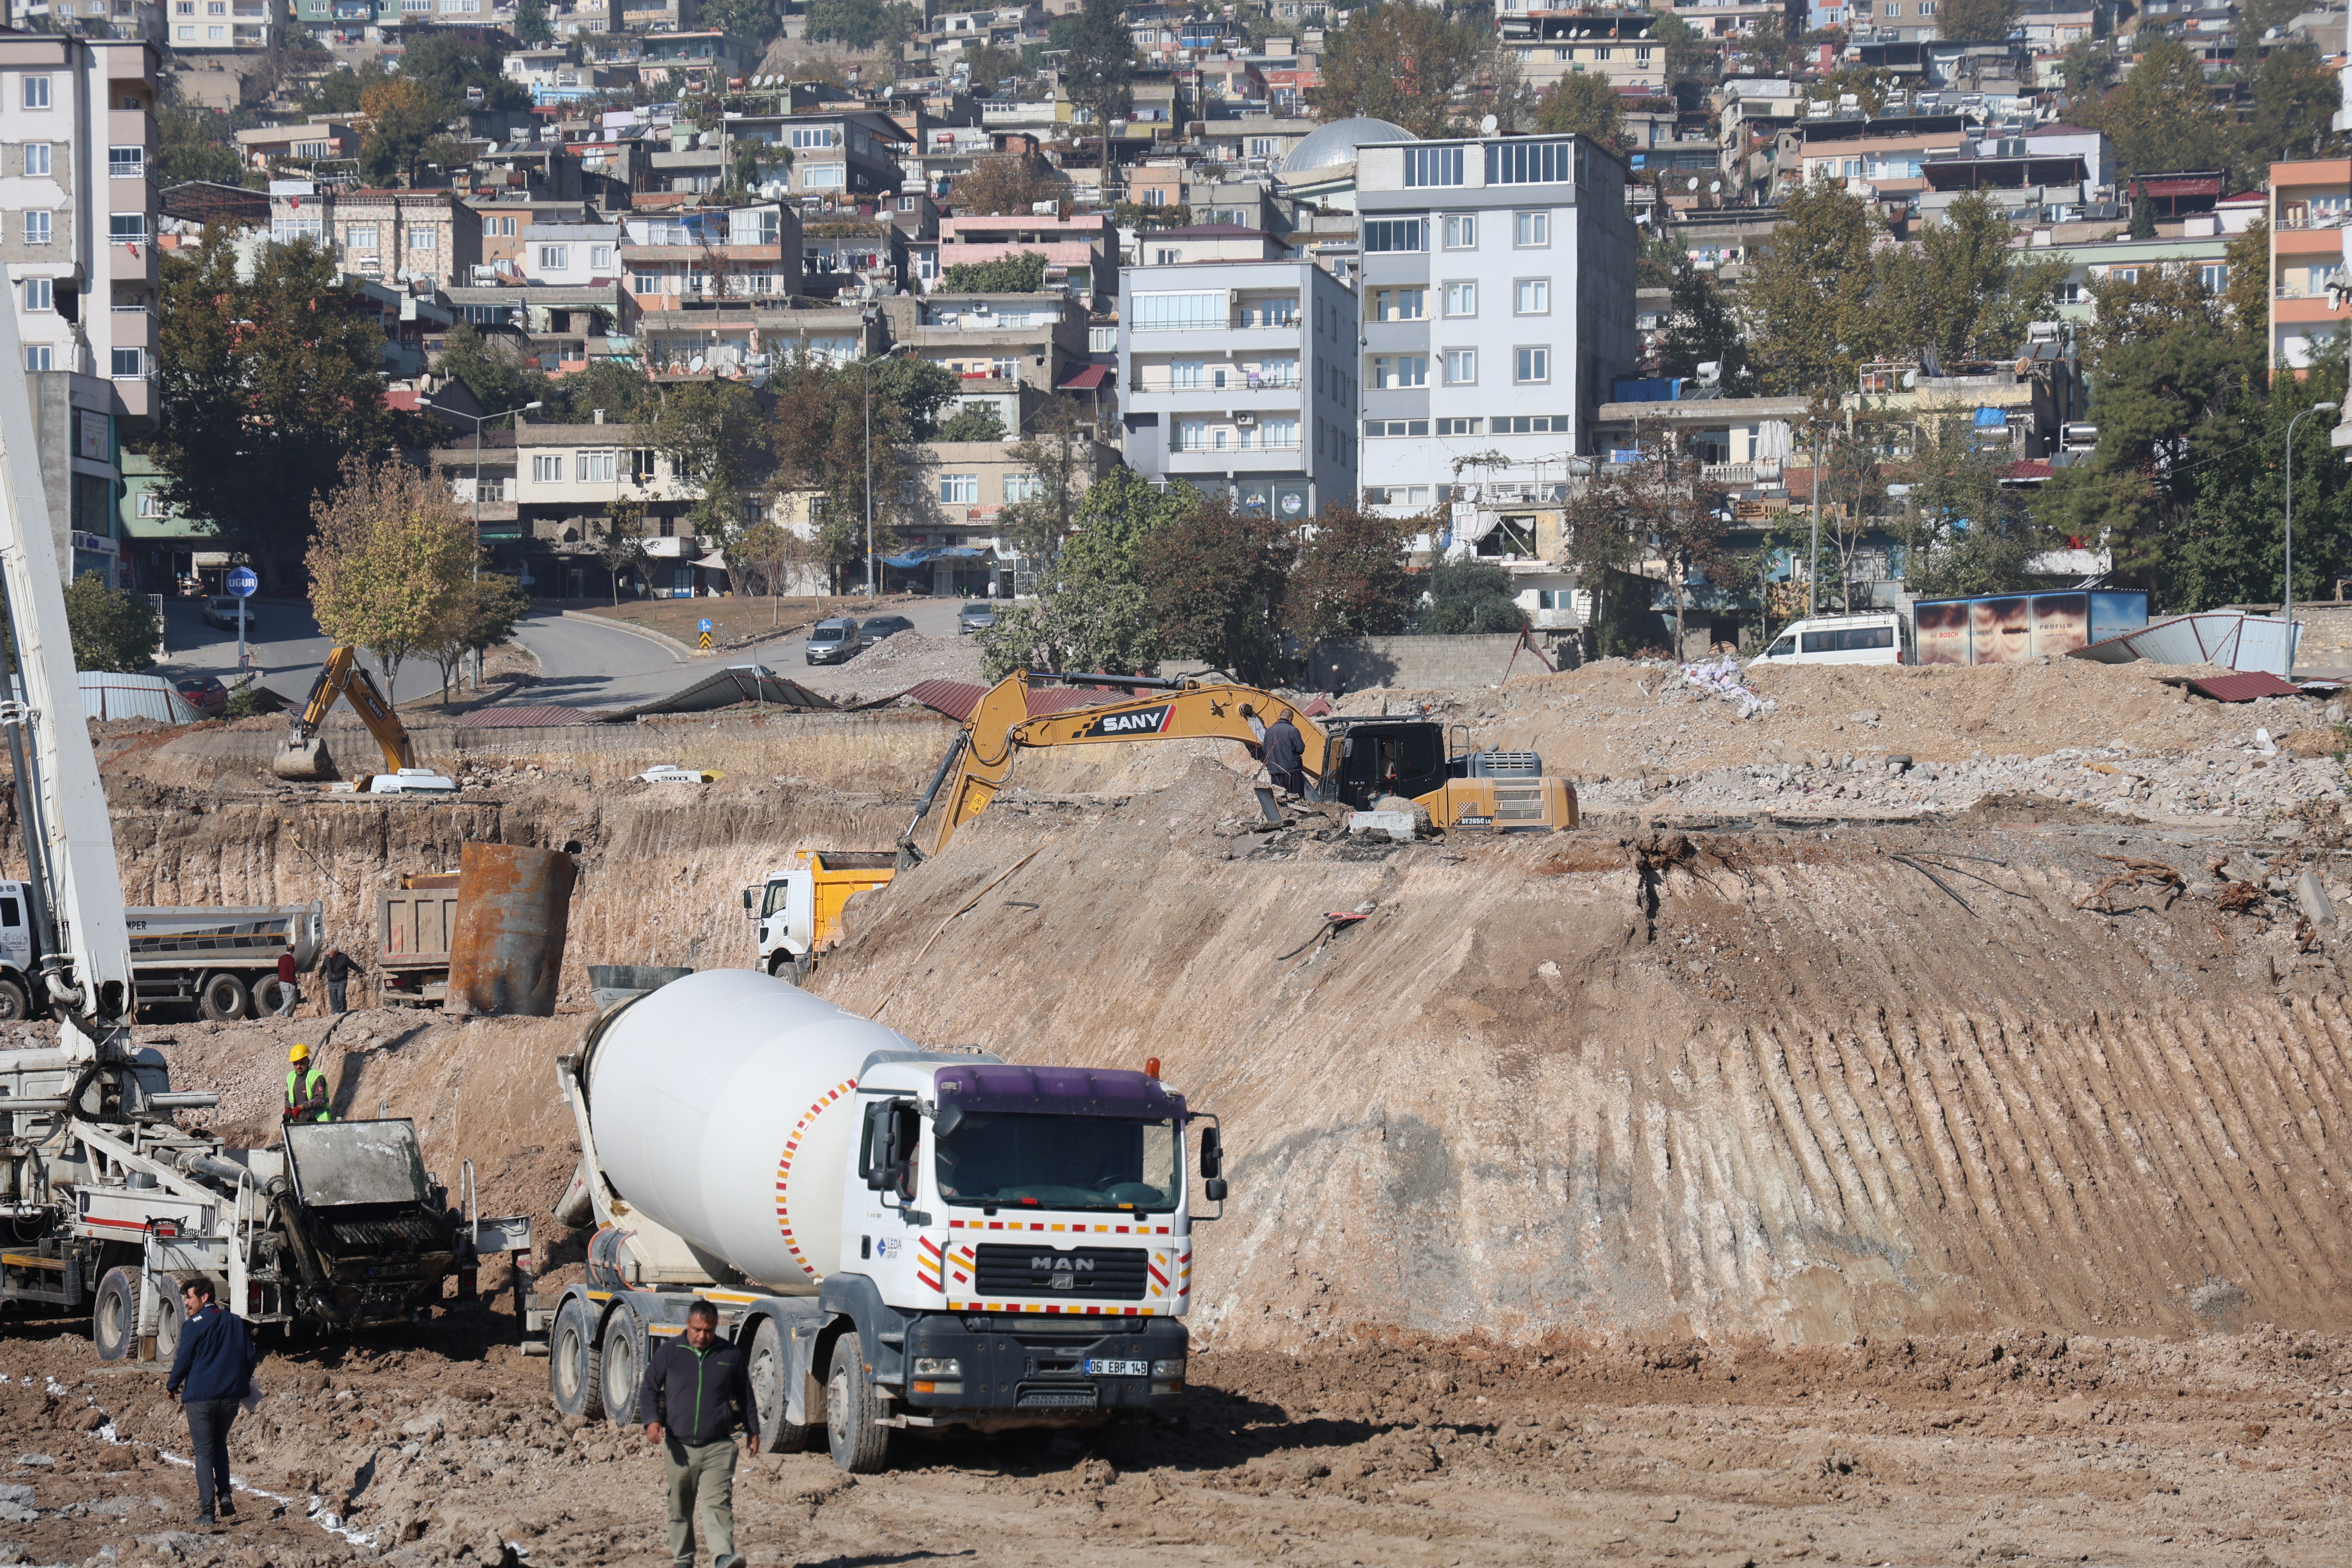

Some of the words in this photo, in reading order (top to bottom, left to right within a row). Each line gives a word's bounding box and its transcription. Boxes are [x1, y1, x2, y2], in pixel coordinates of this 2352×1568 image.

[368, 699, 383, 718] SANY
[1103, 713, 1160, 731] SANY
[887, 1239, 902, 1250] LEDA
[1032, 1257, 1094, 1270] MAN
[373, 1267, 382, 1276] 06
[387, 1265, 401, 1275] EBP
[1090, 1361, 1102, 1373] 06
[1109, 1361, 1125, 1373] EBP
